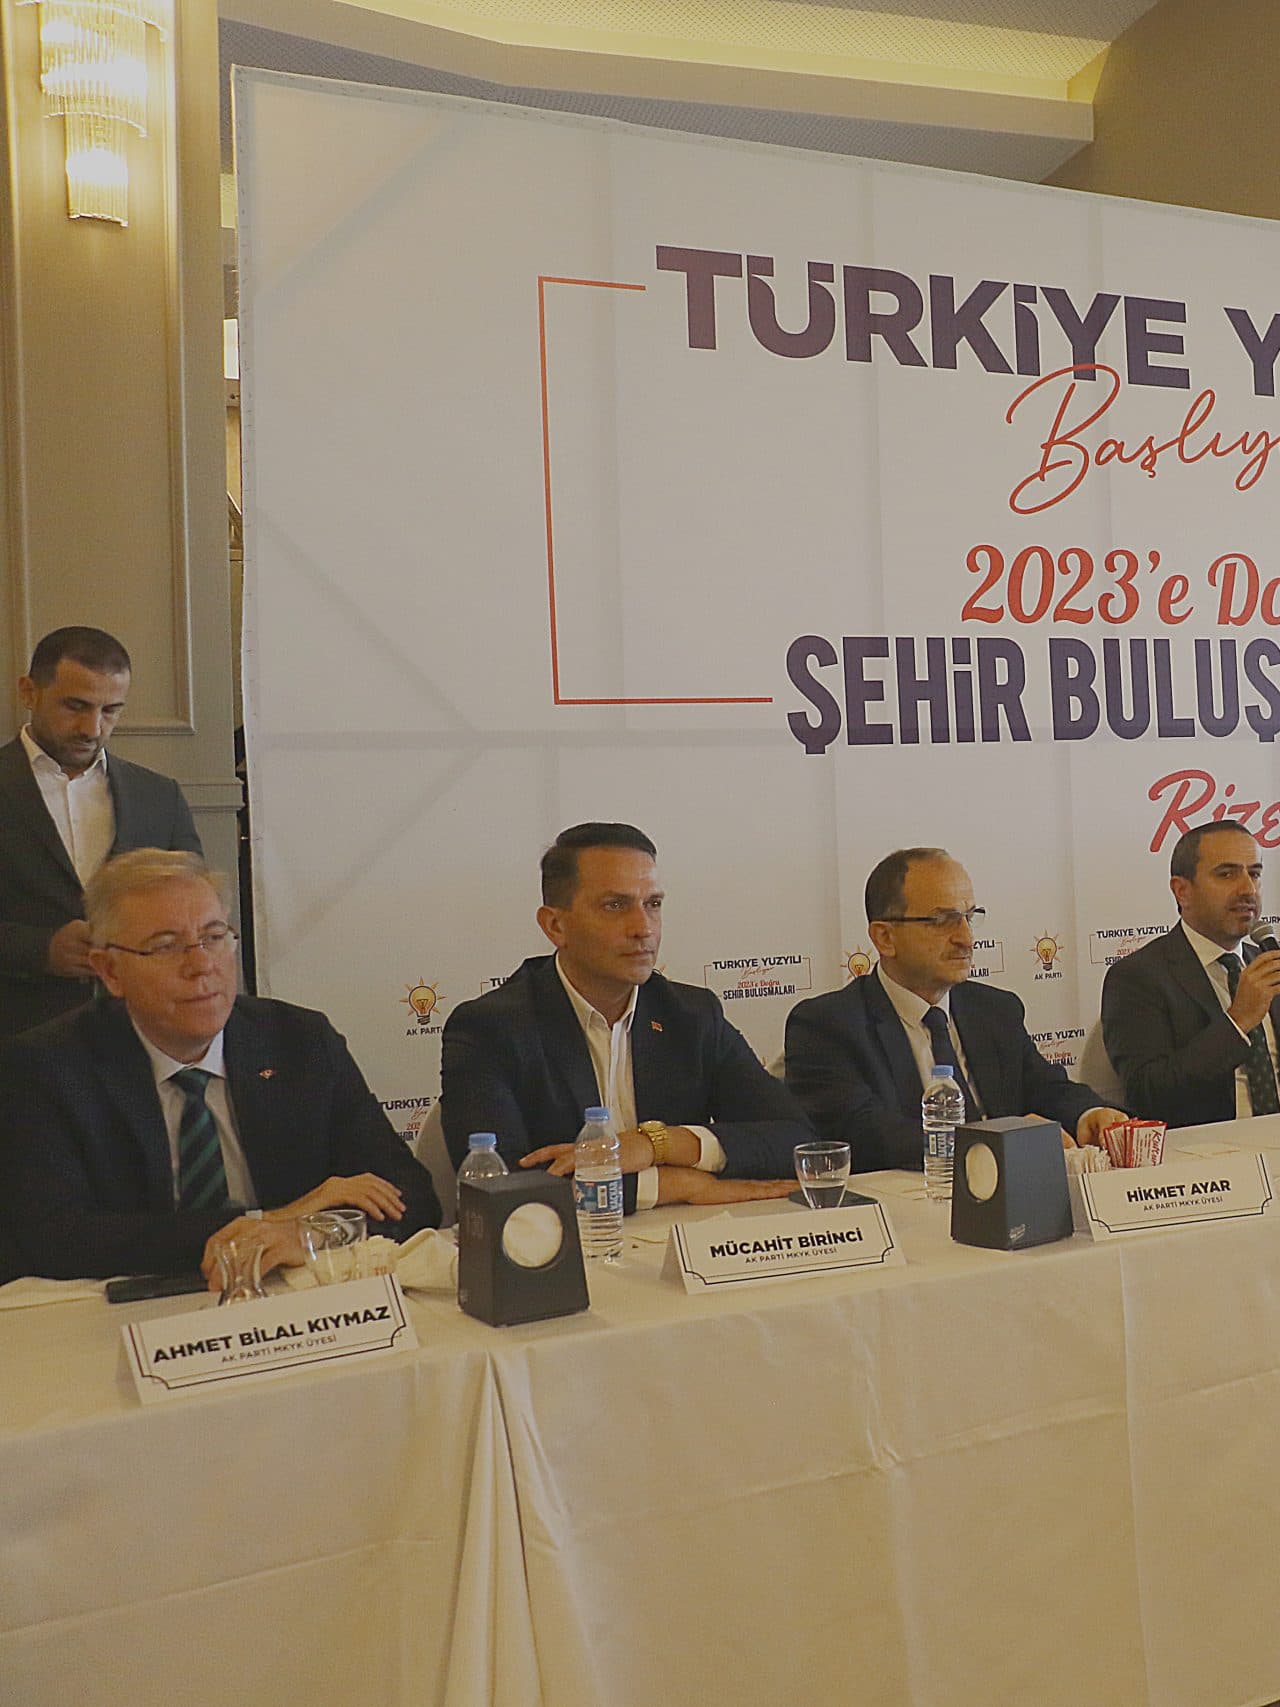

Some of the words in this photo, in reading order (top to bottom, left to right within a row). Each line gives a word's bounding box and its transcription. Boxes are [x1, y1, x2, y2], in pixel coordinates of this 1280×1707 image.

[656, 245, 1190, 389] TÜRKİYE
[786, 636, 1032, 755] ŞEHİR
[1126, 1184, 1186, 1202] HİKMET
[1190, 1180, 1231, 1195] AYAR
[1156, 1201, 1178, 1211] PARTİ
[1179, 1200, 1200, 1208] MKYK
[1202, 1195, 1223, 1205] ÜYESİ
[710, 1235, 794, 1258] MÜCAHİT
[798, 1228, 864, 1249] BİRİNCİ
[760, 1253, 784, 1263] PARTİ
[786, 1250, 810, 1260] MKYK
[812, 1247, 837, 1257] ÜYESİ
[153, 1335, 233, 1364] AHMET
[239, 1326, 304, 1347] BİLAL
[308, 1306, 392, 1333] KIYMAZ
[221, 1355, 237, 1364] AK
[239, 1347, 271, 1362] PARTİ
[273, 1341, 304, 1356] MKYK
[306, 1334, 337, 1348] ÜYESİ
